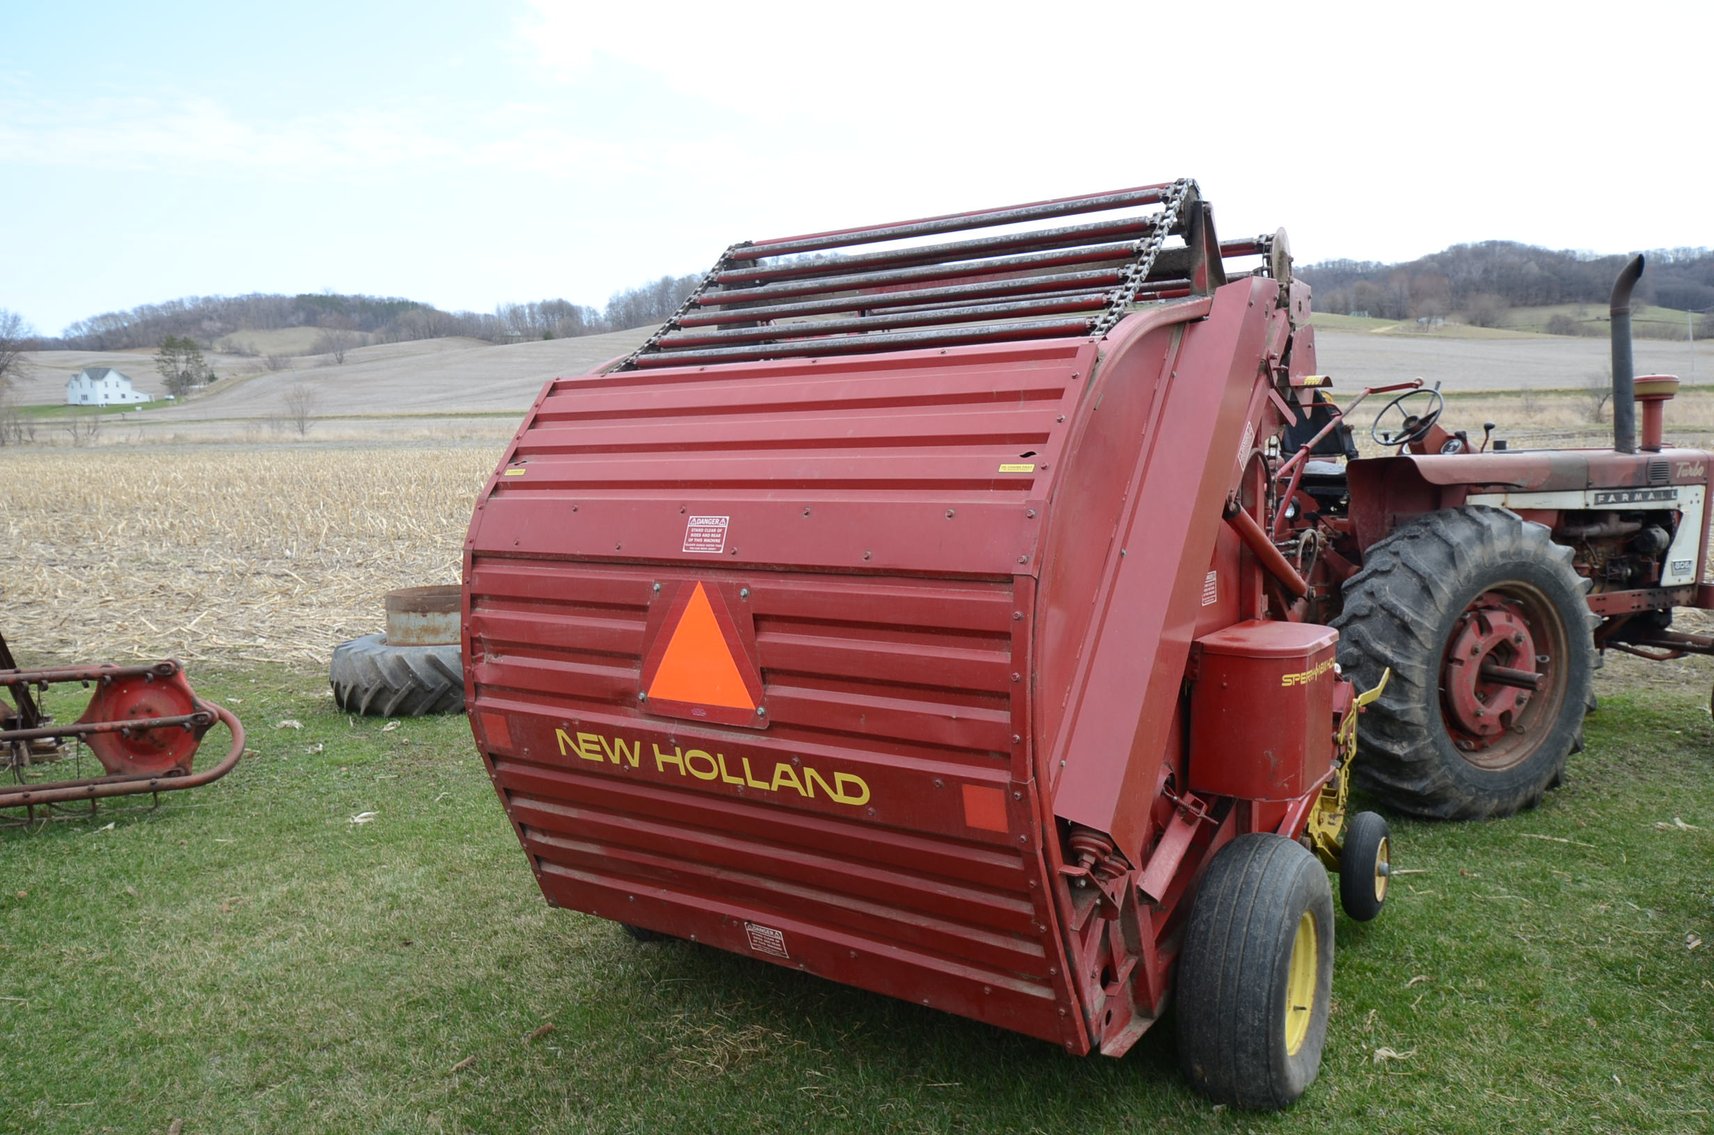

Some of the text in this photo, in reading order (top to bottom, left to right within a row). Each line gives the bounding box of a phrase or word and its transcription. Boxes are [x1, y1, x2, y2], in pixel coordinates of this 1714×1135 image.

[1675, 460, 1705, 478] Turbo
[1597, 490, 1677, 503] FARMALL
[555, 728, 871, 806] NEW HOLLAND
